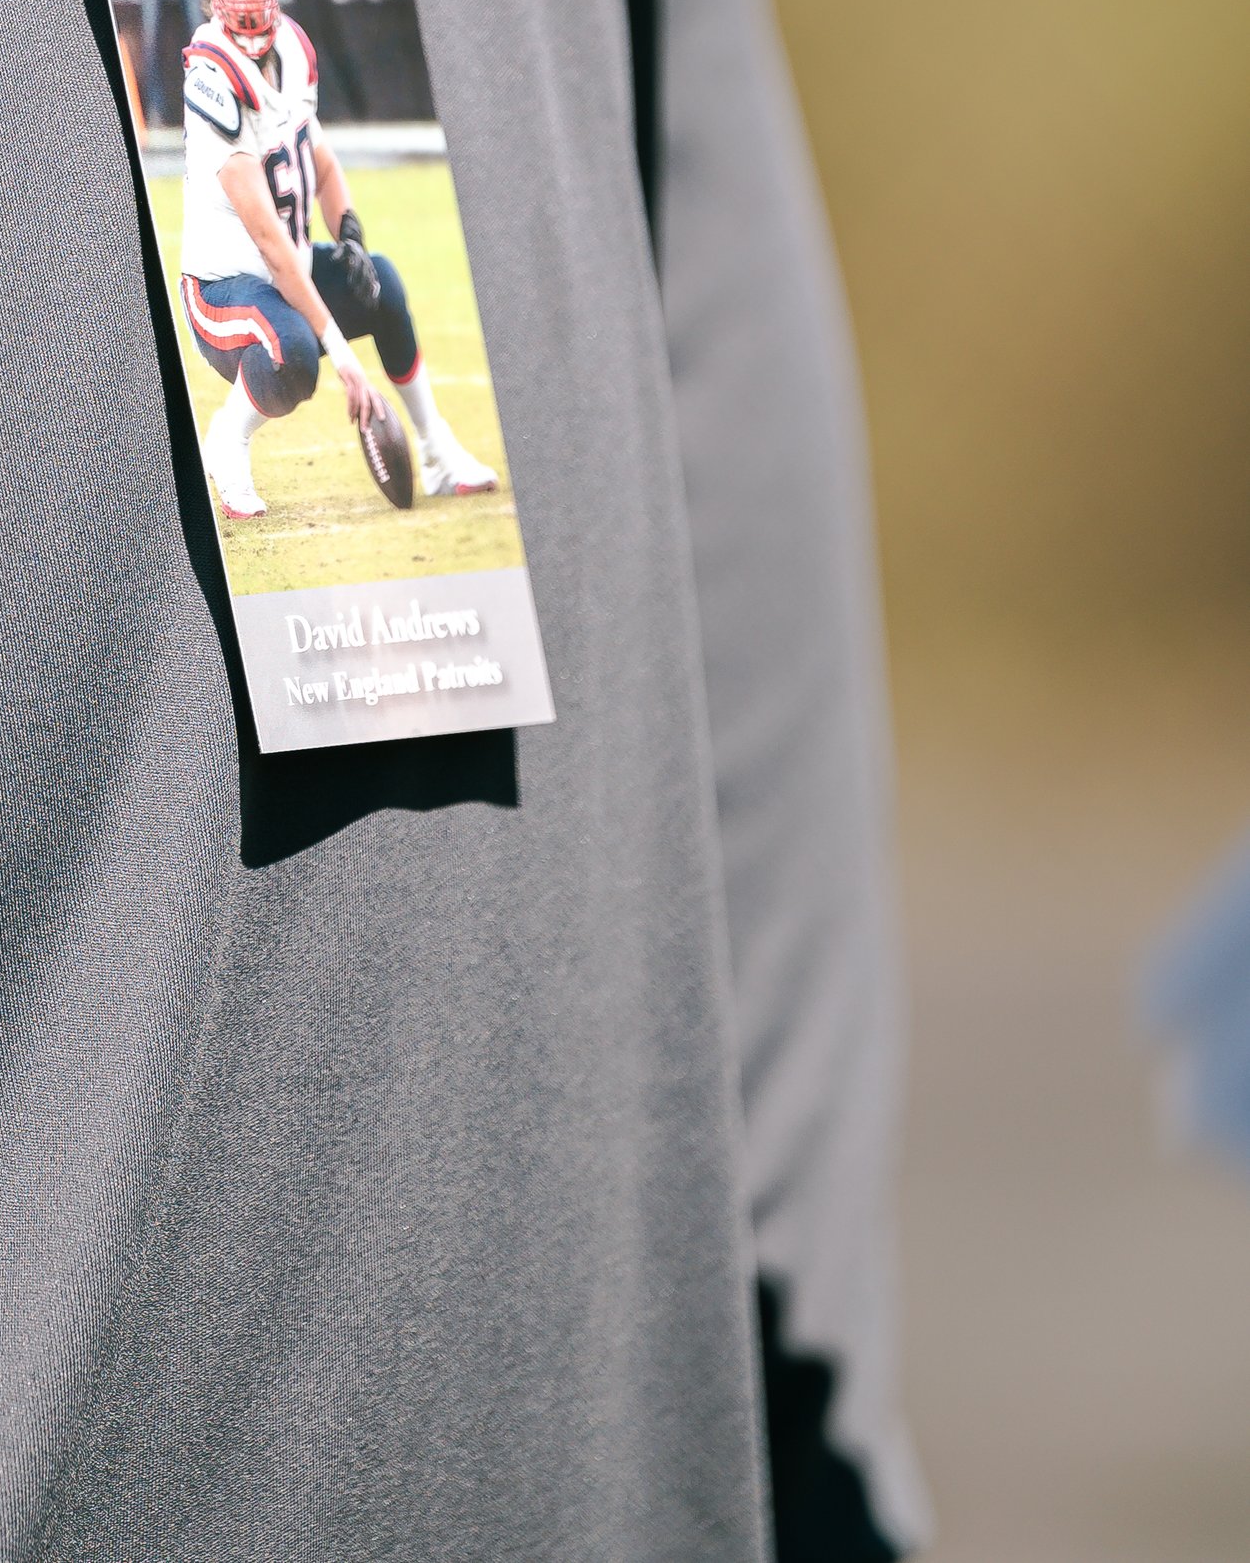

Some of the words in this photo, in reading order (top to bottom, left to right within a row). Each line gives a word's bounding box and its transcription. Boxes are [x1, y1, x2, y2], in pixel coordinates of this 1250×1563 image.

[286, 607, 366, 653] David
[372, 601, 480, 645] Andrews
[283, 676, 329, 706] New
[333, 667, 420, 705] England
